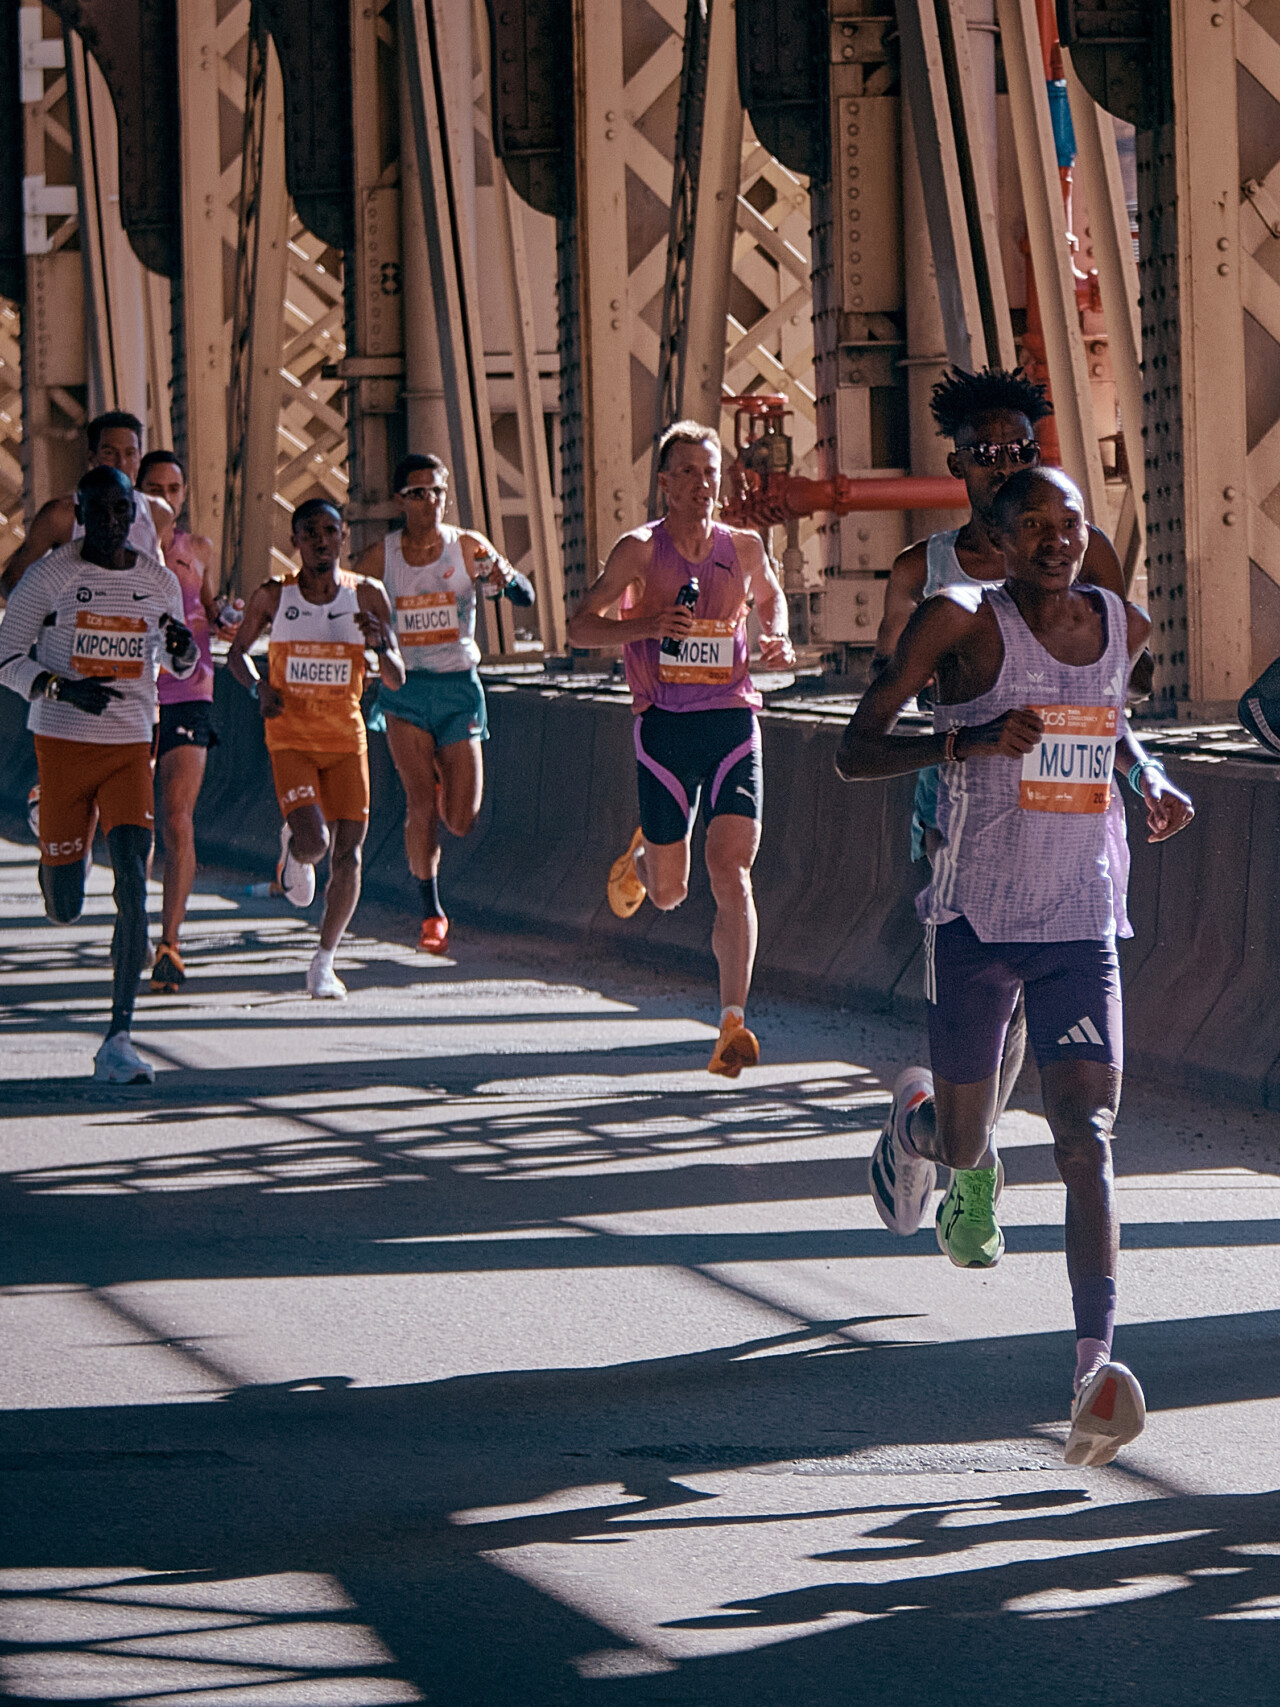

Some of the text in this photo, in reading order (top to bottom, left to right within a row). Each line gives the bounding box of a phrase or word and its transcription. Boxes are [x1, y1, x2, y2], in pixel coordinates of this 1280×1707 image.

[404, 610, 450, 630] MEUCCI
[75, 633, 145, 659] KIPCHOGE
[676, 642, 719, 664] MOEN
[290, 661, 348, 682] NAGEEYE
